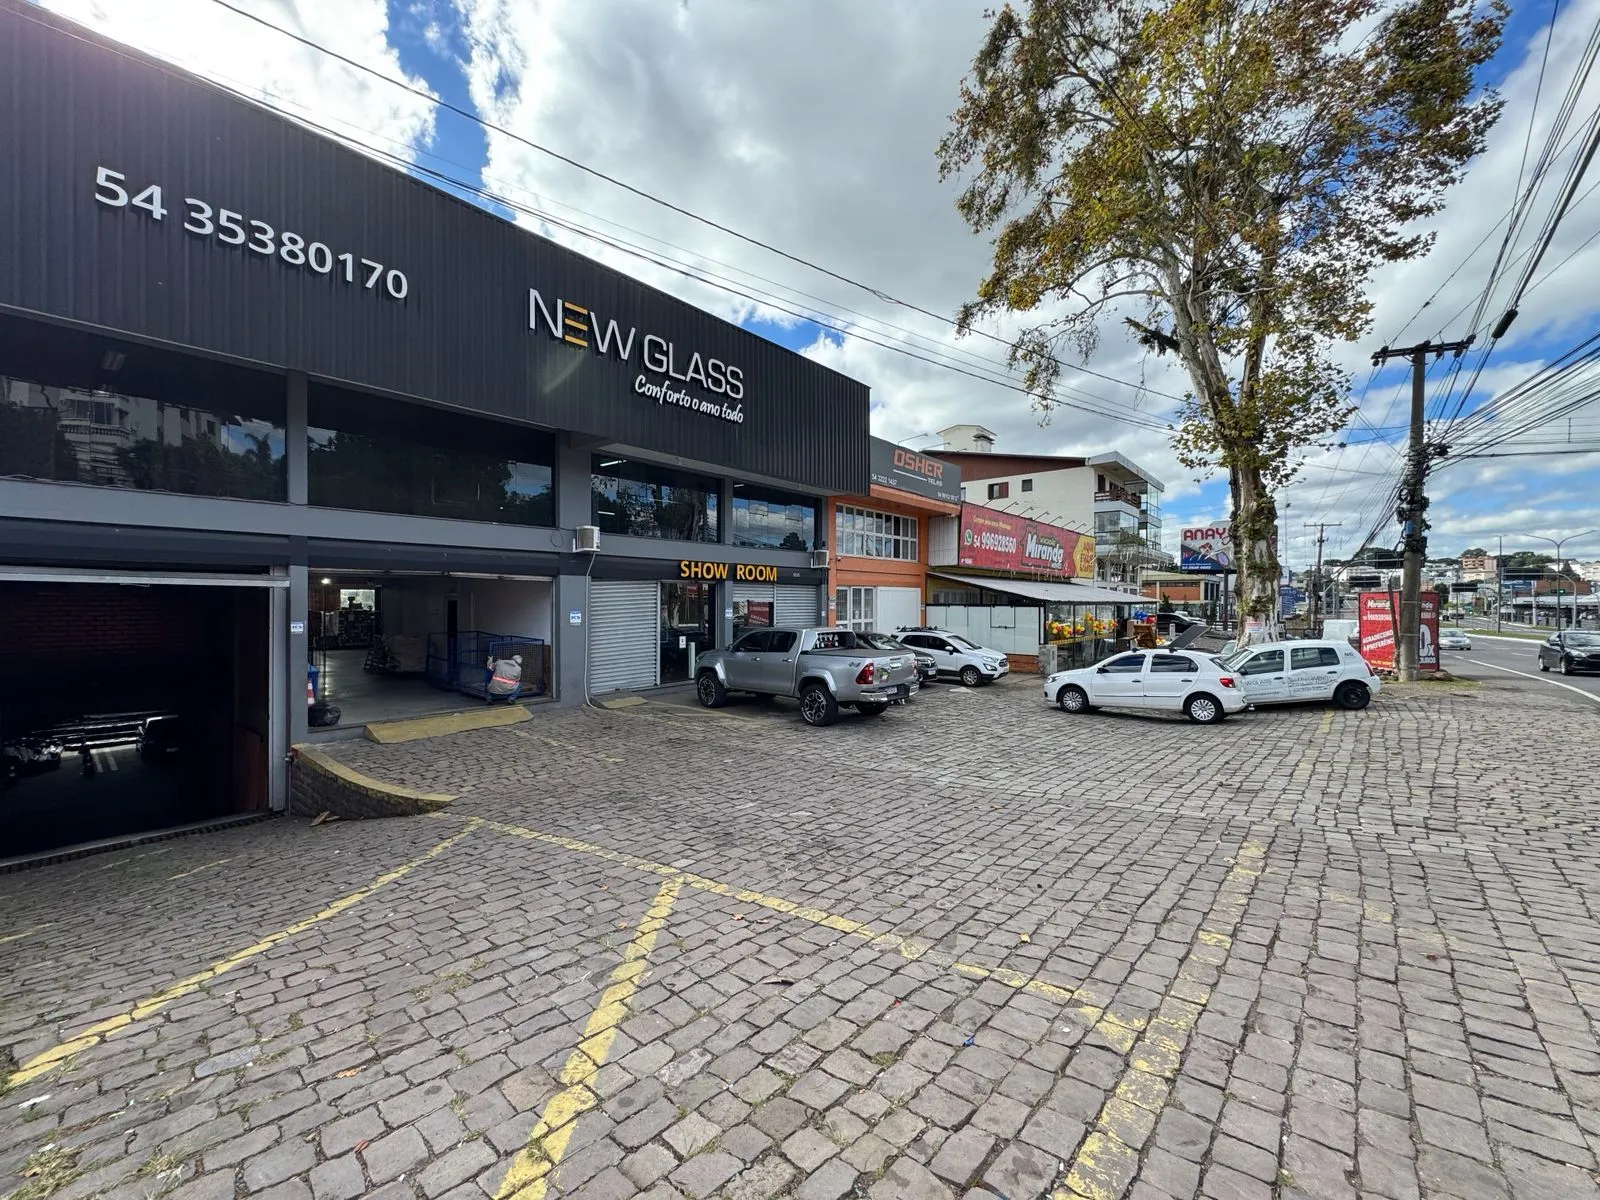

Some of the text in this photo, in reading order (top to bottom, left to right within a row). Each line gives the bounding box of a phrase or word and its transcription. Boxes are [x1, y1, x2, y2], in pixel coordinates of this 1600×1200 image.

[94, 166, 409, 299] 54 35380170
[529, 287, 744, 400] NEW GLASS
[634, 374, 744, 423] Conforto o ano todo
[893, 448, 944, 480] OSHER
[927, 477, 944, 487] TELAS
[973, 534, 981, 549] 54
[1025, 533, 1064, 563] Miranda
[680, 559, 778, 582] SHOW ROOM
